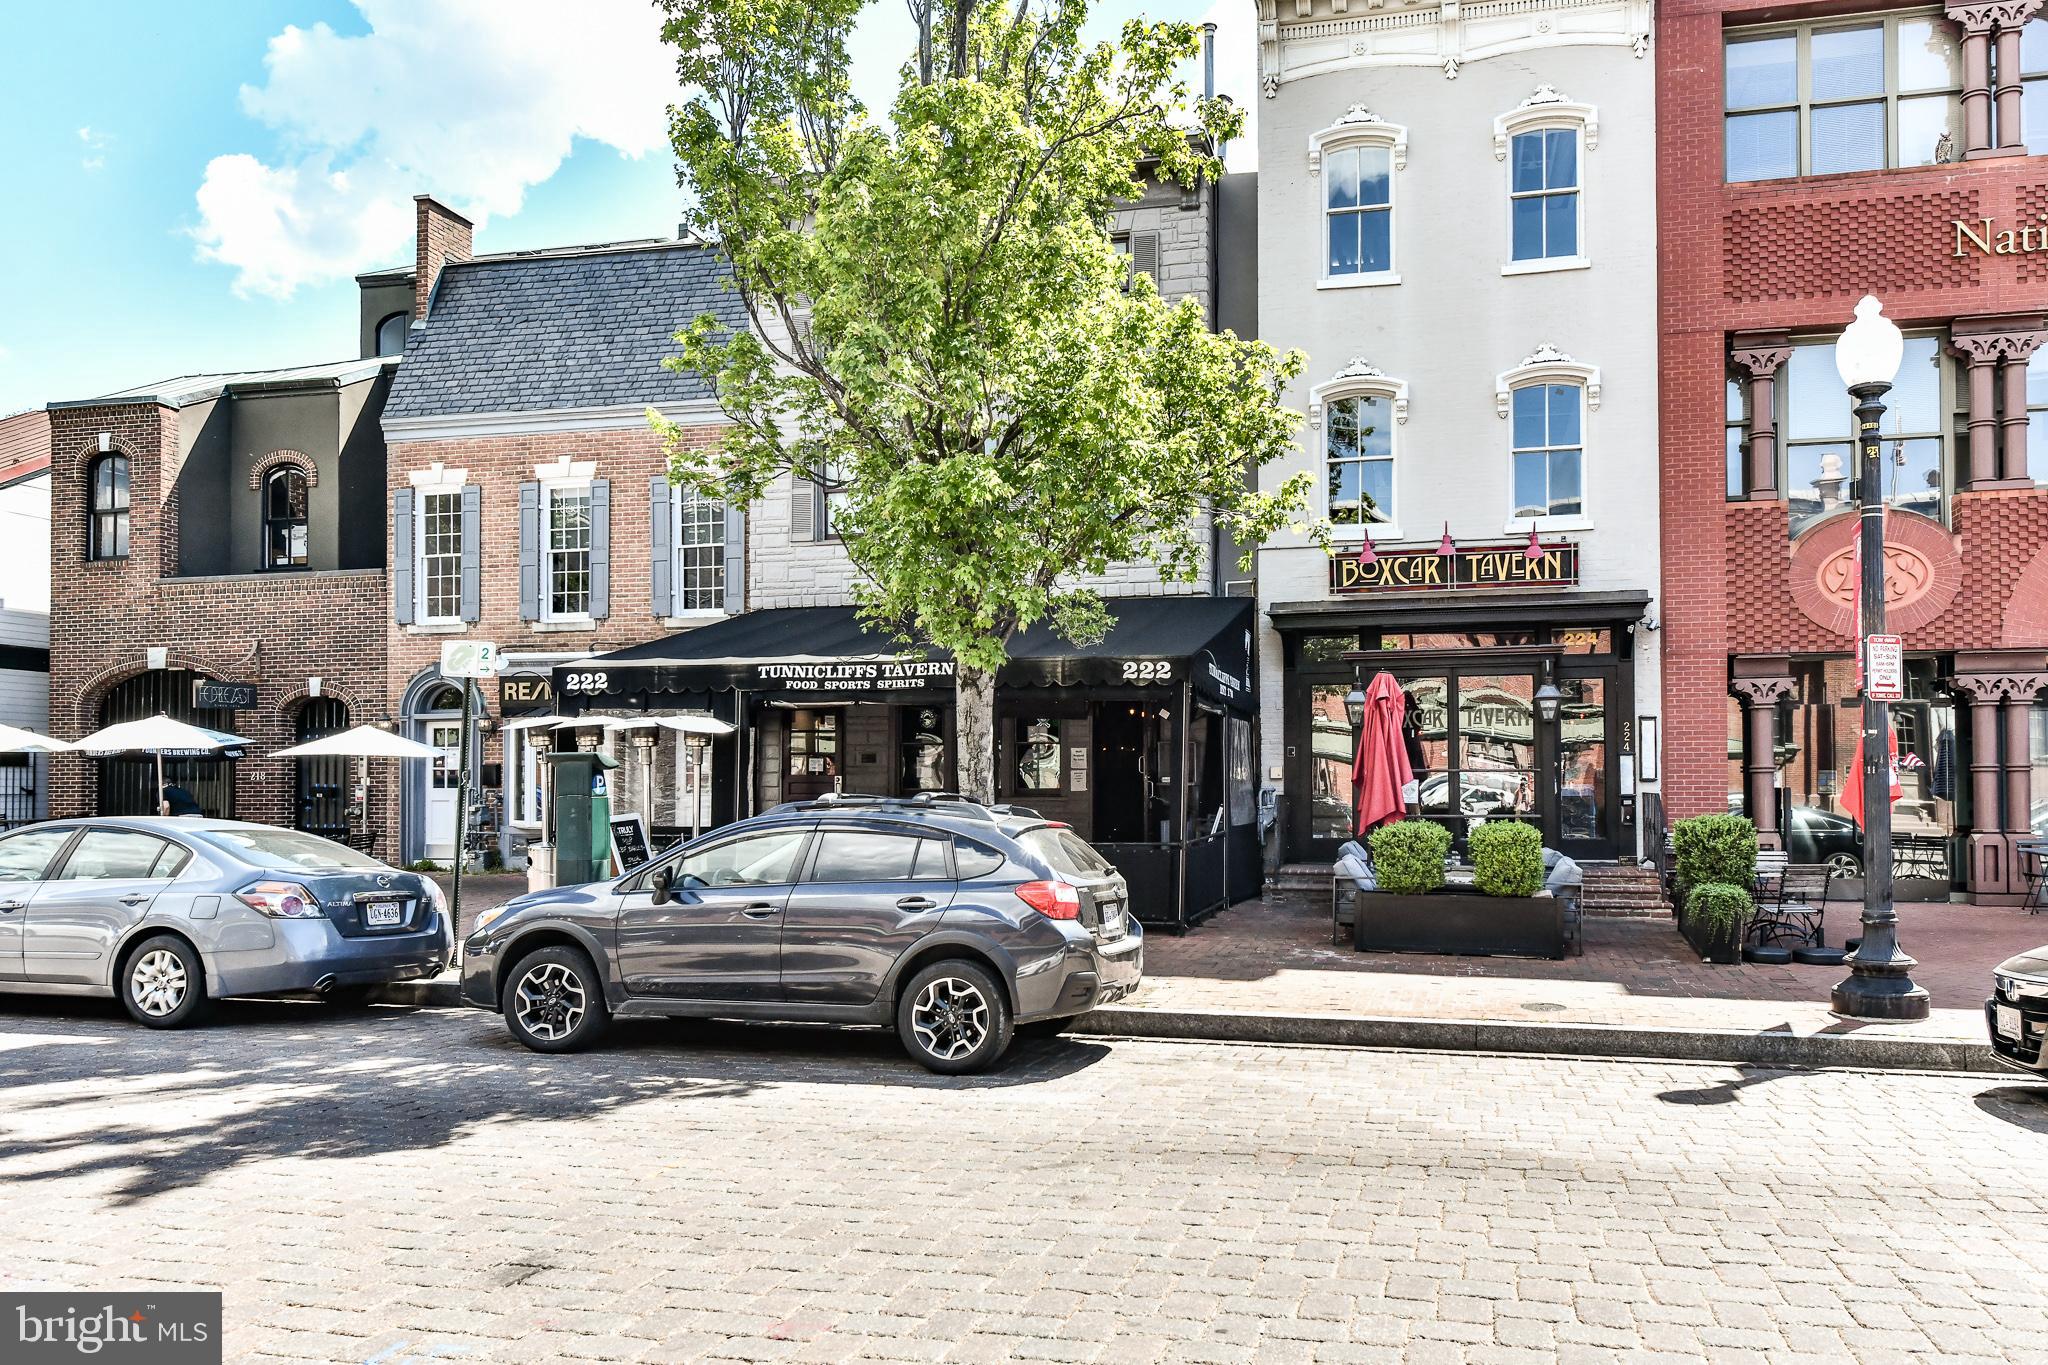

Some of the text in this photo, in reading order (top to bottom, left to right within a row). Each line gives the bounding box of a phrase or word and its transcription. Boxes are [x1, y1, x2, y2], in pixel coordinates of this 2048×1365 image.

[1951, 213, 2048, 257] Nati
[1342, 551, 1562, 587] BOXCAR TAVERN
[1563, 632, 1598, 646] 224
[481, 647, 489, 660] 2
[758, 662, 955, 679] TUNNICLIFFS TAVERN
[1122, 661, 1172, 679] 222
[566, 672, 608, 690] 222
[785, 678, 925, 690] FOOD SPORTS SPIRITS
[1467, 707, 1530, 727] TAVERN
[142, 747, 172, 756] FOUNERS
[172, 748, 200, 756] BREWING
[250, 771, 266, 781] 218
